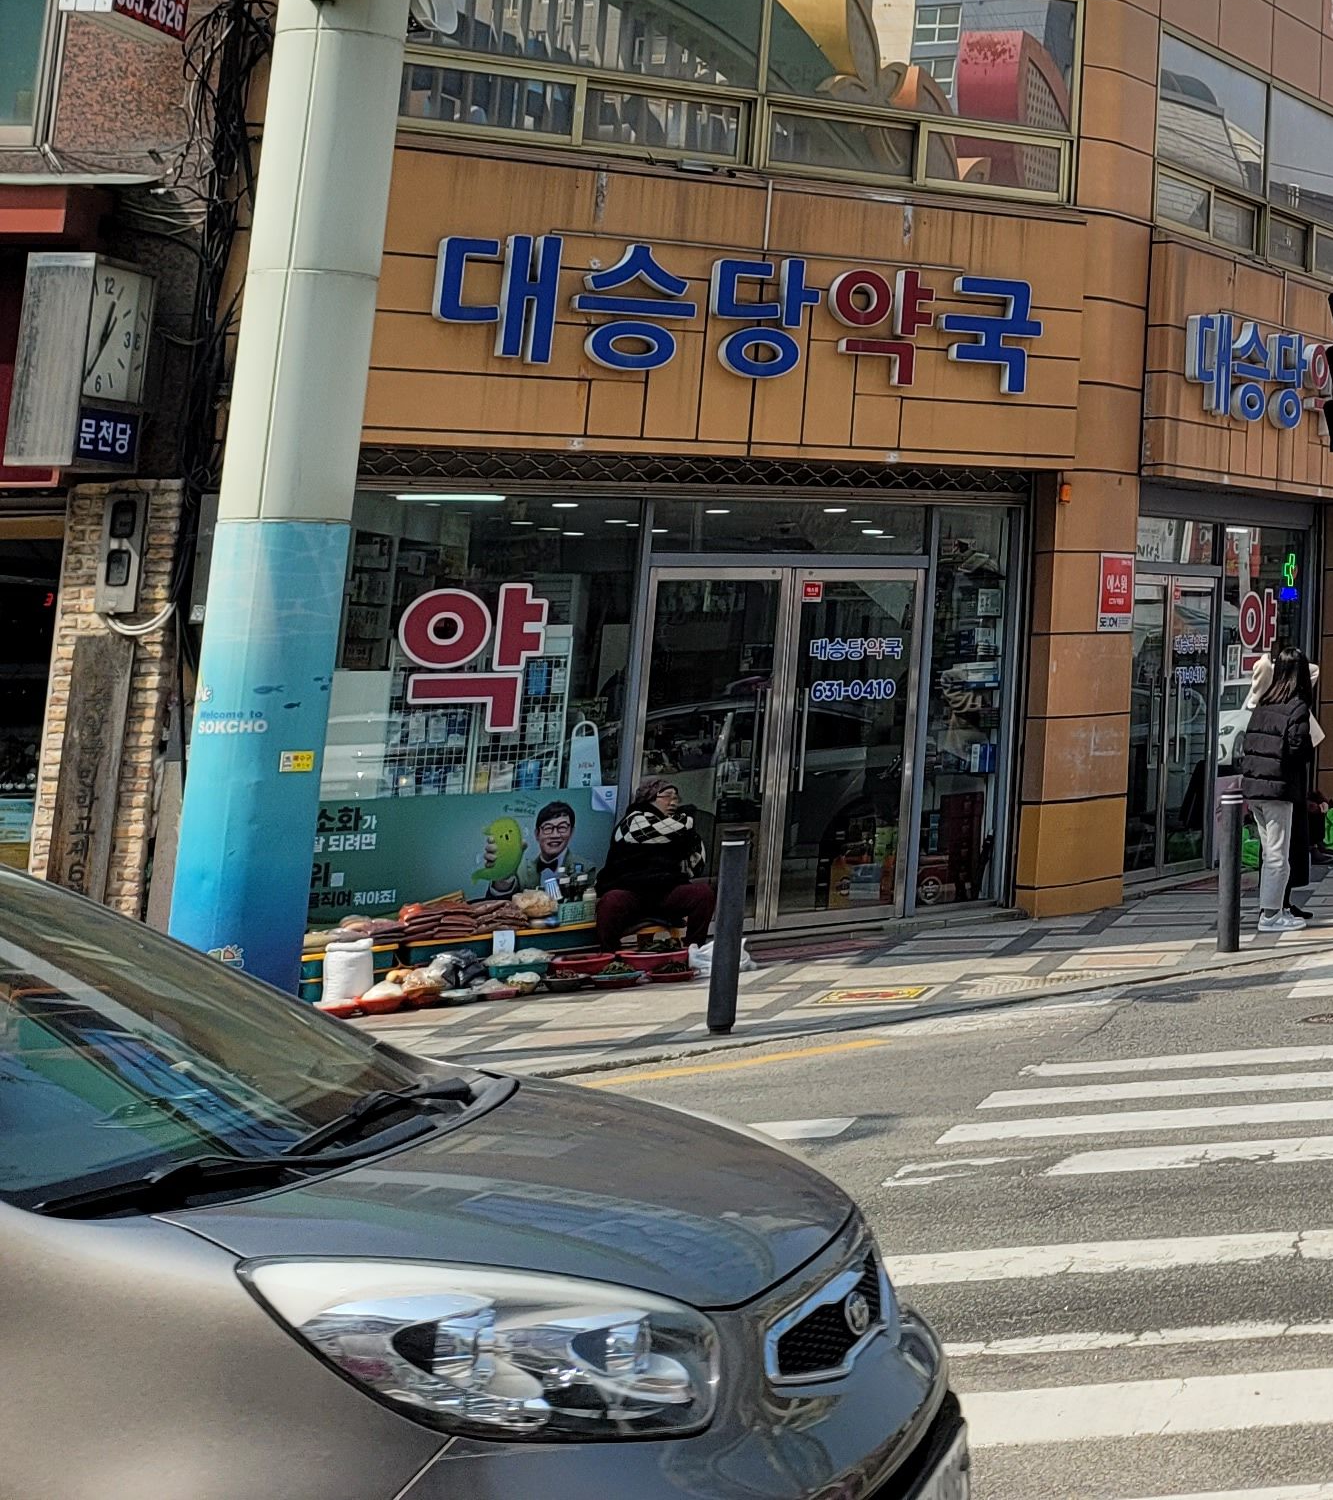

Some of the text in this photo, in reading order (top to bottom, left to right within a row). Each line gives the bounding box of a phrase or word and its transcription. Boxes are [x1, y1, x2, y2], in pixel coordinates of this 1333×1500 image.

[432, 233, 1044, 396] 대승당약국
[79, 417, 132, 454] 문천당
[399, 582, 549, 733] 약
[809, 638, 904, 661] 대승당약국
[811, 679, 896, 701] 631-0410
[249, 710, 263, 719] to
[198, 719, 269, 734] SOKCHO
[316, 805, 378, 833] 소화가
[327, 832, 377, 852] 되려면
